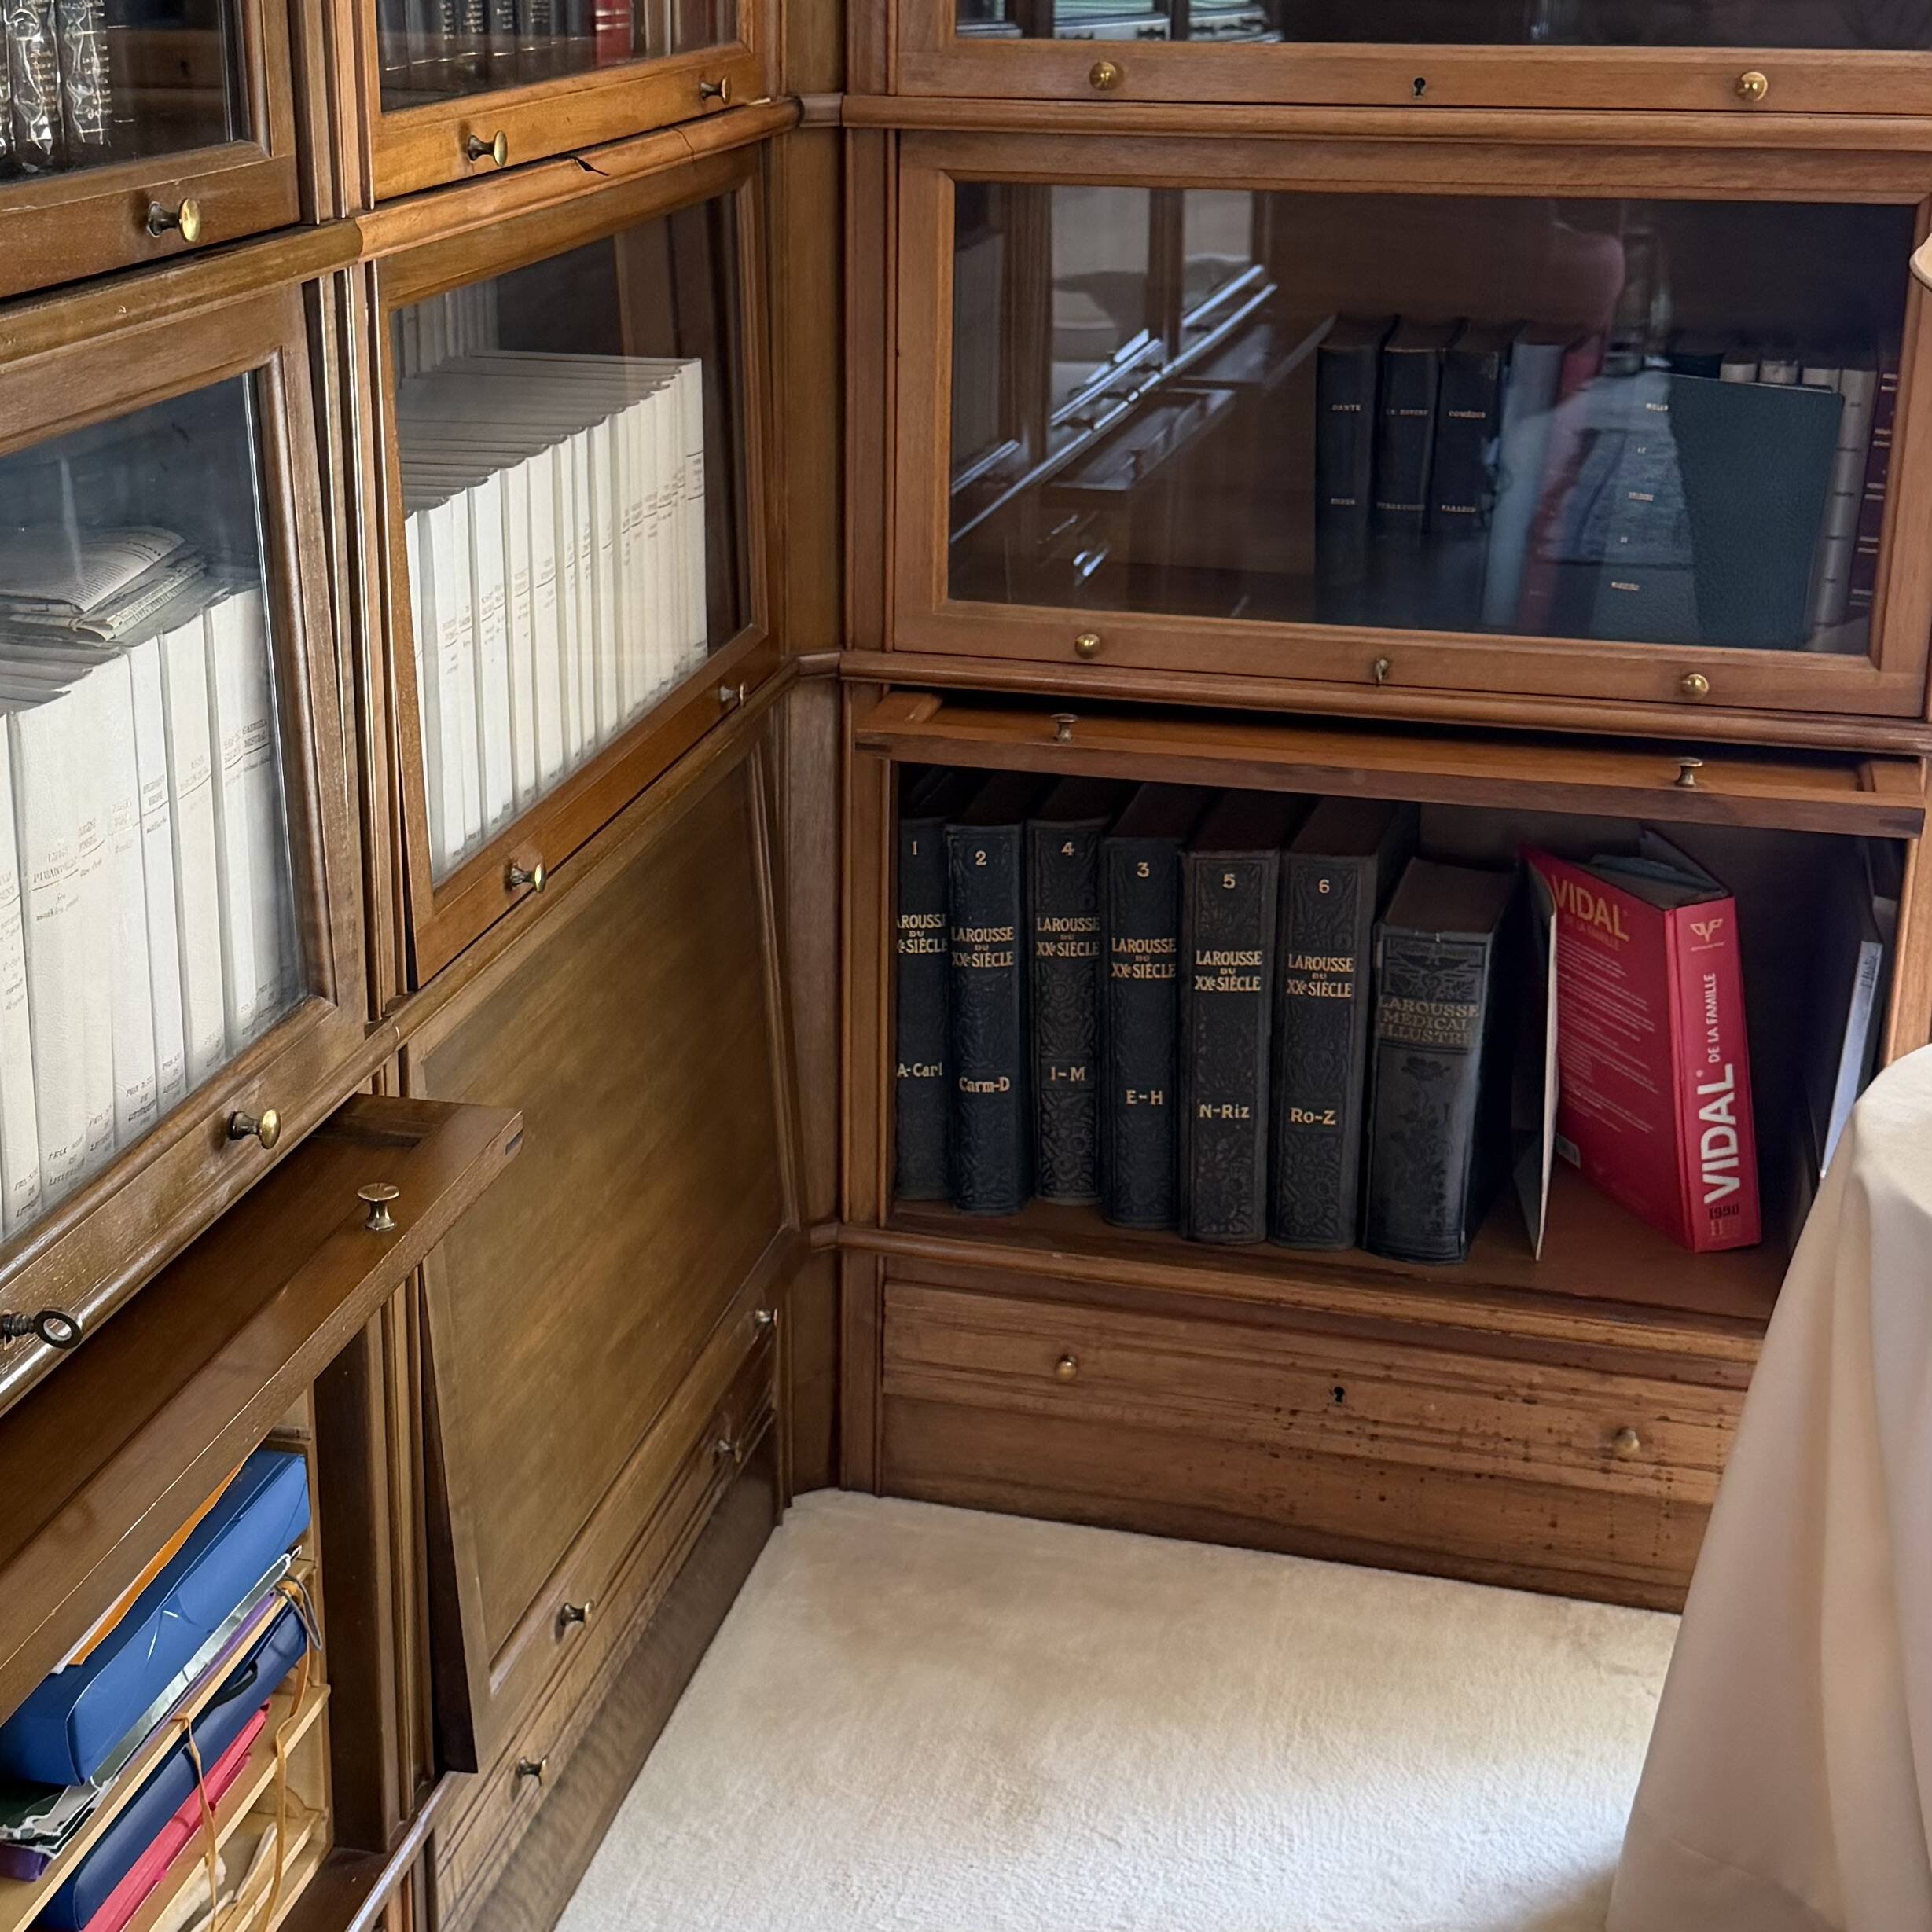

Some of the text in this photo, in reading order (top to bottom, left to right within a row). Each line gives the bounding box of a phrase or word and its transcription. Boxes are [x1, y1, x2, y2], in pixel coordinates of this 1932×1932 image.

[912, 841, 918, 855] 1
[1061, 842, 1075, 856] 4
[975, 850, 987, 865] 2
[1137, 862, 1150, 877] 3
[1222, 873, 1236, 889] 5
[1319, 880, 1330, 894] 6
[1551, 874, 1629, 942] VIDAL
[1037, 917, 1100, 932] LAROUSSE
[951, 927, 1014, 942] LAROUSSE
[1111, 938, 1176, 953] LAROUSSE
[1196, 950, 1262, 966] LAROUSSE
[1288, 953, 1354, 972] LAROUSSE
[1380, 997, 1479, 1018] LAROUSSE
[959, 1075, 1011, 1093] Carm-D
[1697, 972, 1740, 1204] VIDAL DE LA FAMILLE
[1199, 1104, 1250, 1119] N-Riz
[1291, 1107, 1335, 1126] Ro-Z
